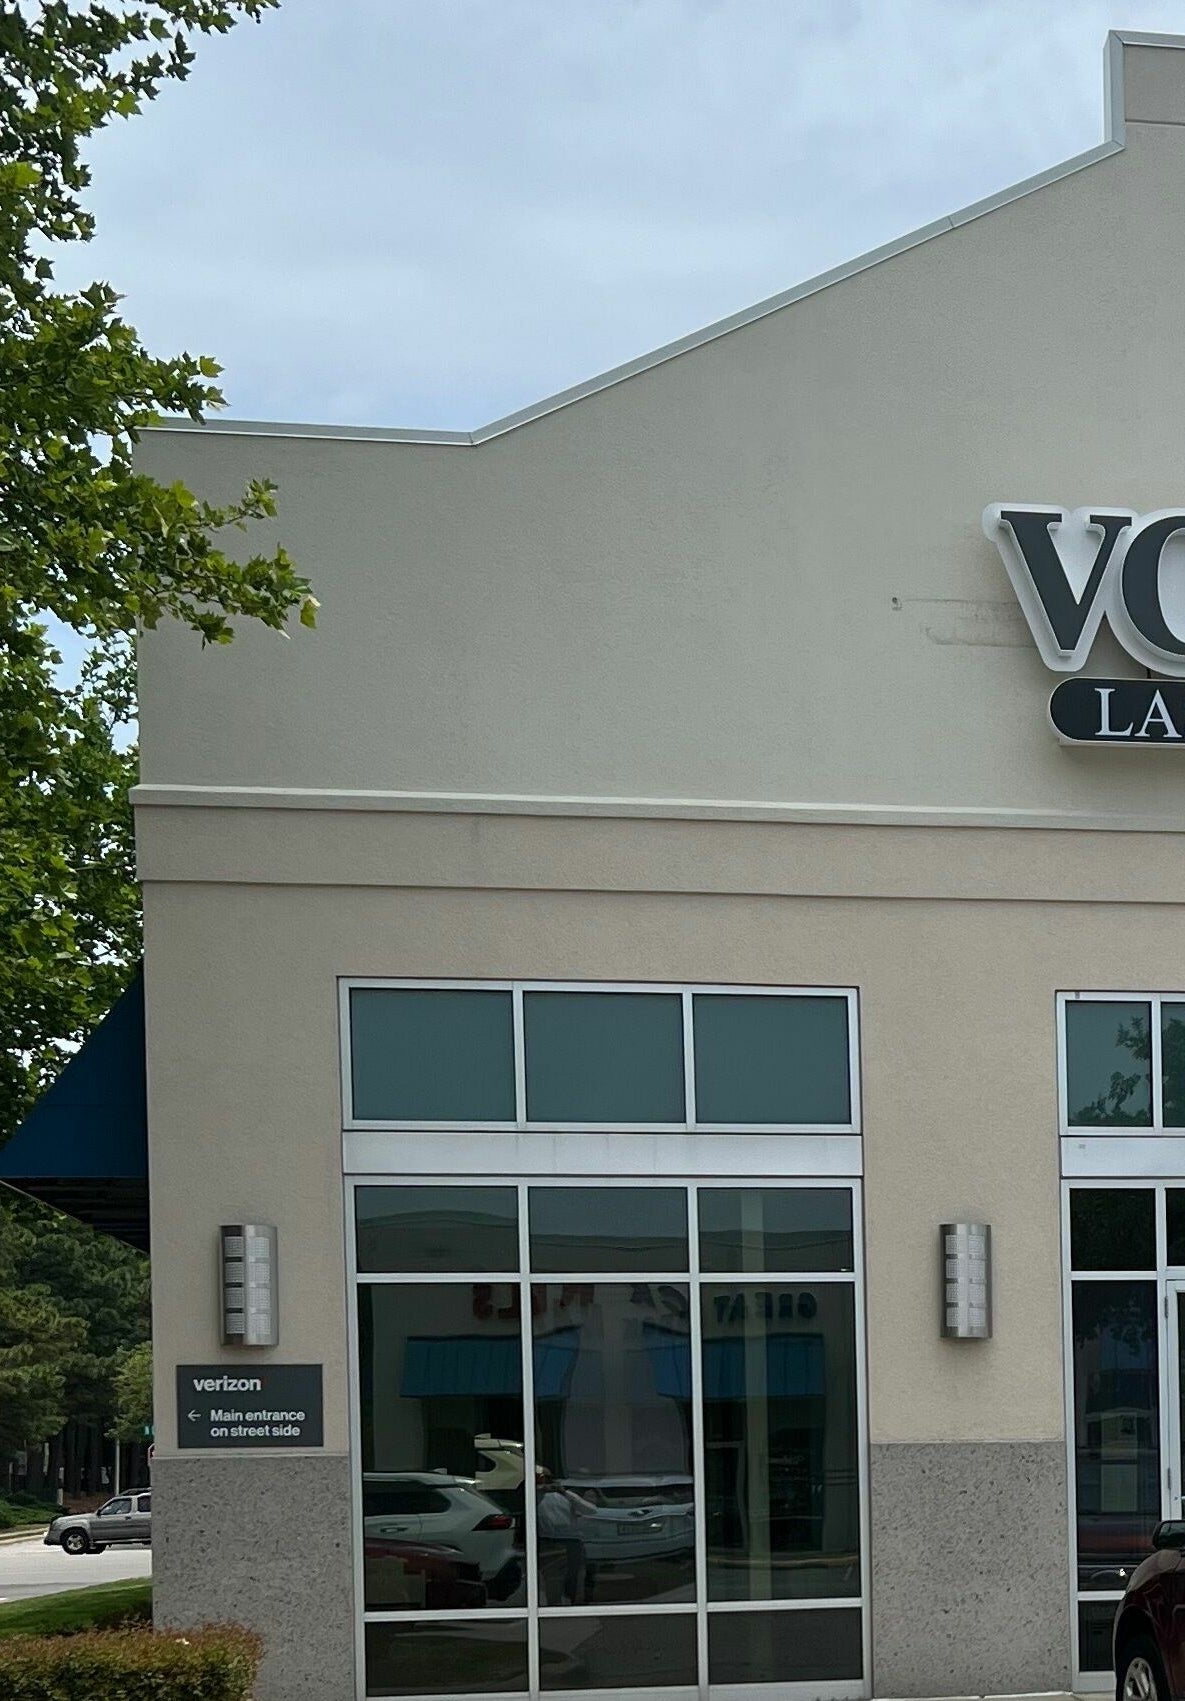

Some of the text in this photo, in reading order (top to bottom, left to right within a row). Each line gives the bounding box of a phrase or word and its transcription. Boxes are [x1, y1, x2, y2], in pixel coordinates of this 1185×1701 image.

[193, 1375, 262, 1391] verizon
[210, 1409, 306, 1421] Main entrance
[210, 1424, 301, 1437] on street side
